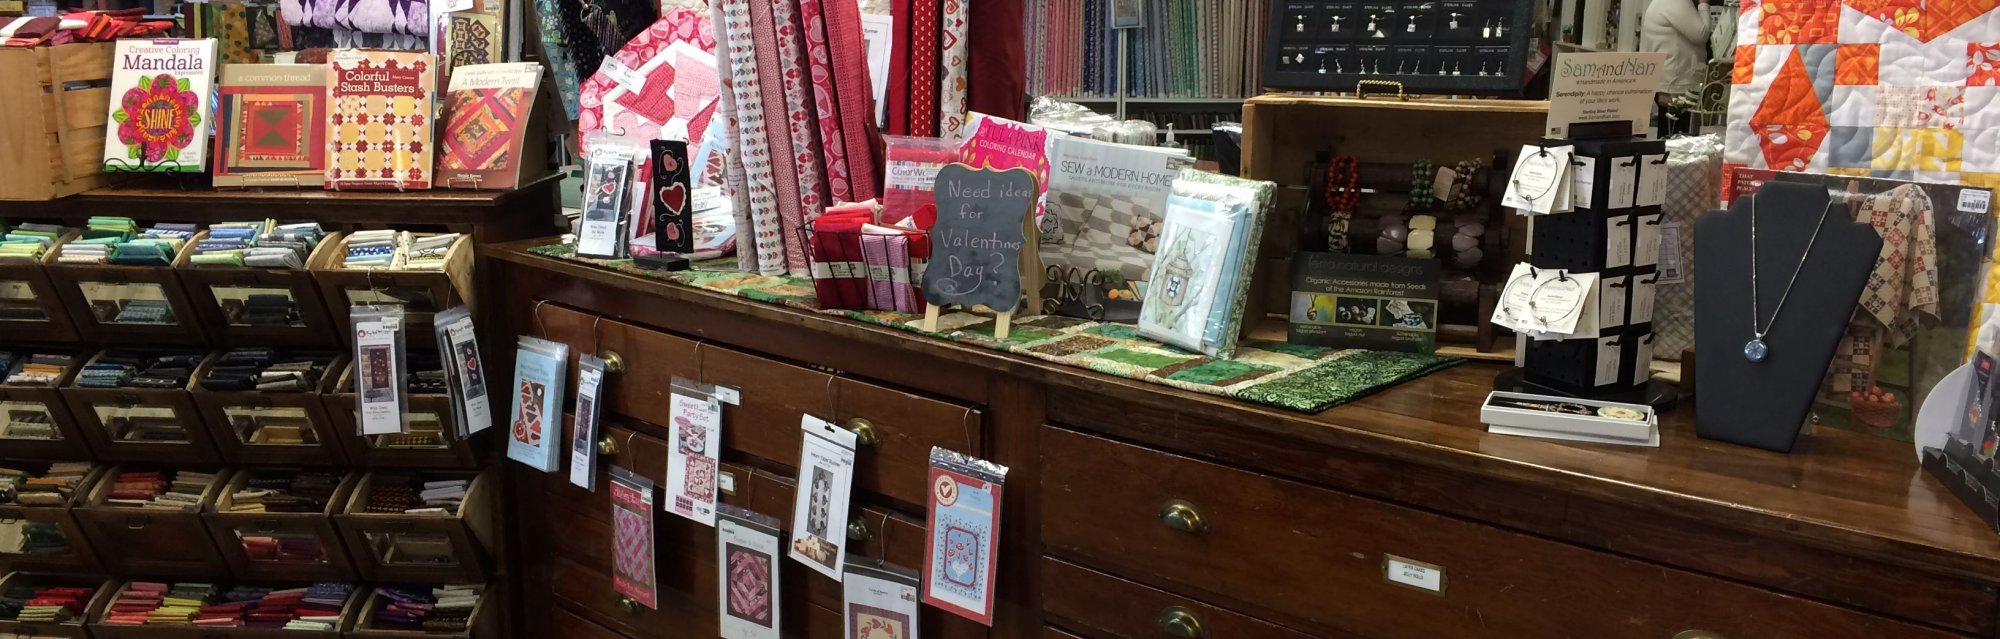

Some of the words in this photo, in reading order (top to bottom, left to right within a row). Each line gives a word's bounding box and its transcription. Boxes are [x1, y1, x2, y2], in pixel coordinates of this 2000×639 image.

[129, 46, 164, 54] Creative
[165, 46, 200, 55] Coloring
[123, 54, 203, 70] Mandala
[284, 73, 311, 81] thread
[345, 71, 389, 81] Colorful
[470, 77, 500, 86] Modern
[502, 76, 520, 85] Twist
[341, 82, 370, 92] Stash
[374, 82, 415, 93] Busters
[145, 108, 175, 129] SHINE
[1015, 132, 1041, 152] PINK
[980, 140, 1006, 153] COLORING
[1007, 147, 1037, 161] CALENDAR
[1061, 160, 1085, 174] SEW
[1087, 167, 1092, 176] a
[1094, 165, 1139, 182] MODERN
[1141, 171, 1173, 187] HOME
[948, 179, 990, 198] Need
[1000, 181, 1032, 198] ideas
[960, 203, 984, 219] for
[941, 228, 1022, 251] Valentines
[1306, 276, 1331, 285] Organic
[1332, 279, 1368, 287] Accessories
[1345, 286, 1372, 294] Amazon
[1373, 288, 1404, 296] Rainforest
